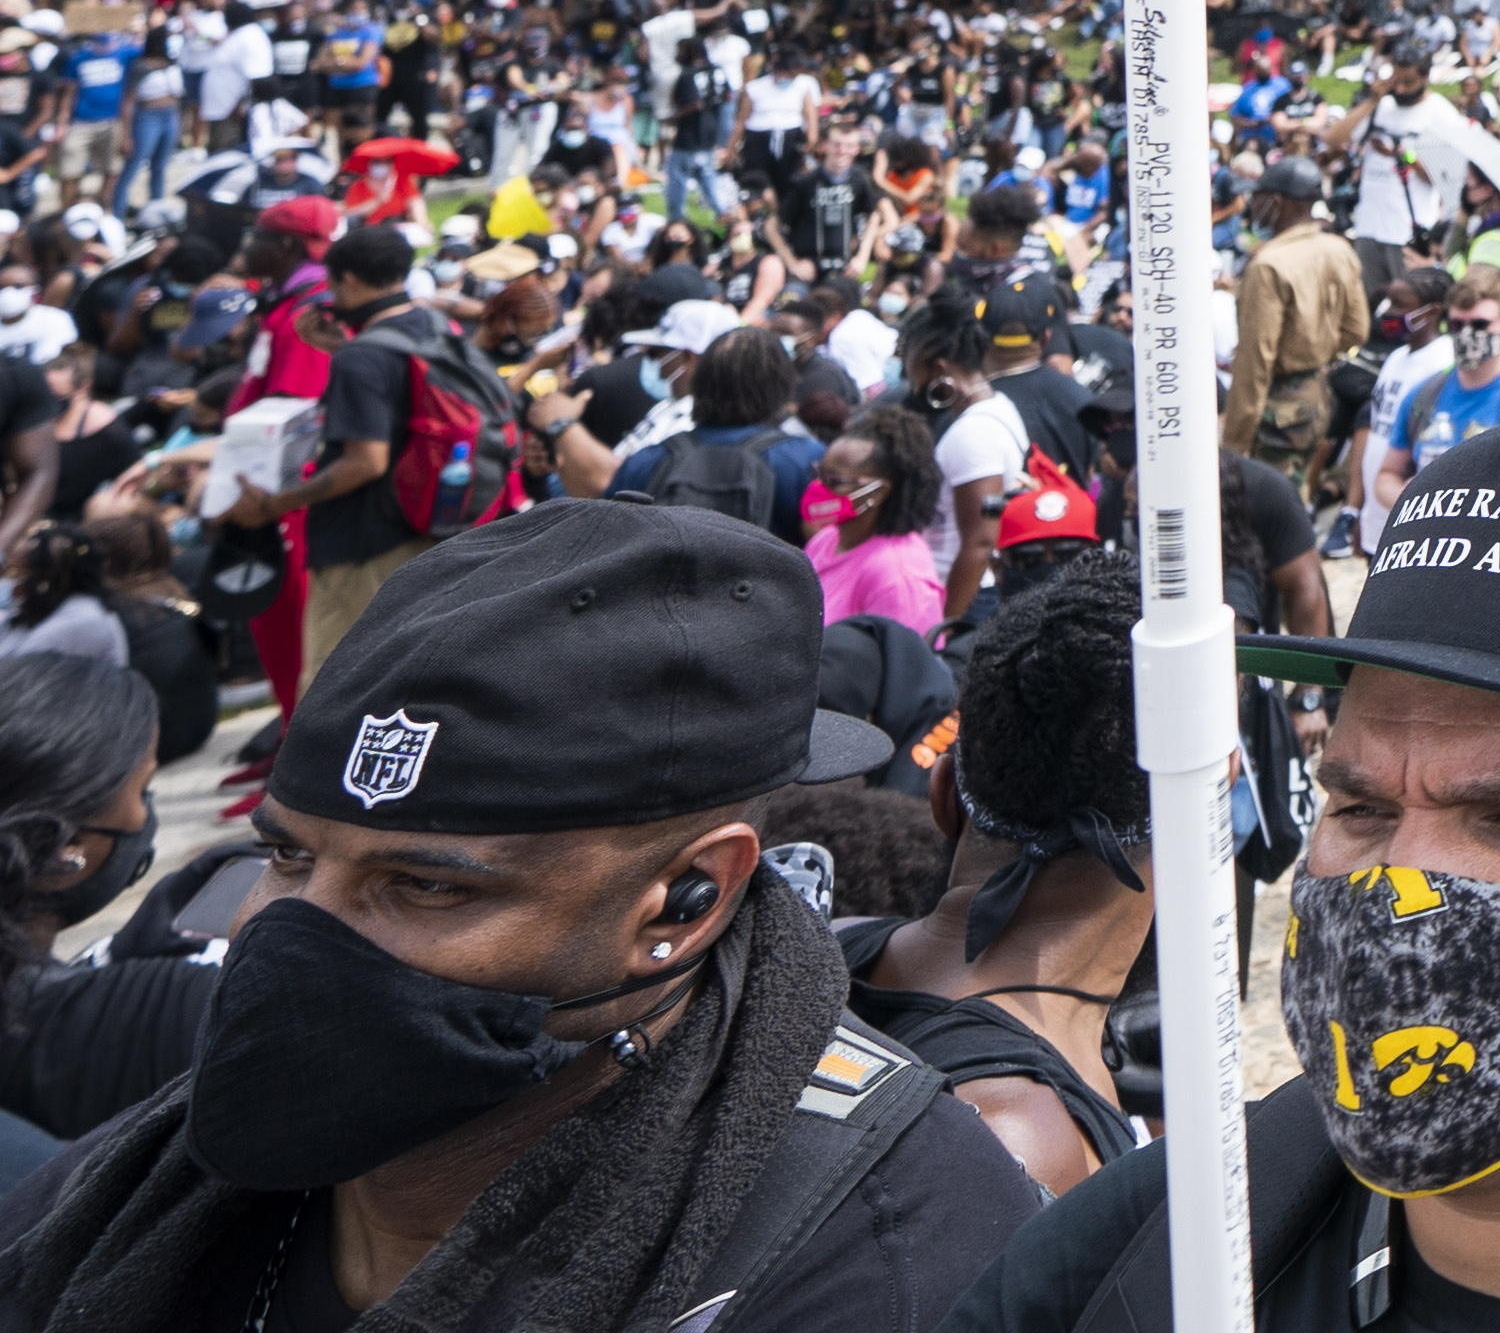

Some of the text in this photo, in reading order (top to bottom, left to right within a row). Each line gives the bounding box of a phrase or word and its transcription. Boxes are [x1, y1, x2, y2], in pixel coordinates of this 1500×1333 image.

[1147, 143, 1173, 233] PVC-1120
[1150, 247, 1177, 314] SCH-40
[1154, 327, 1177, 349] PR
[1155, 362, 1178, 394] 600
[1157, 407, 1181, 438] PSI
[1391, 486, 1466, 528] MAKE
[1370, 538, 1472, 578] AFRAID
[351, 749, 412, 793] NFL
